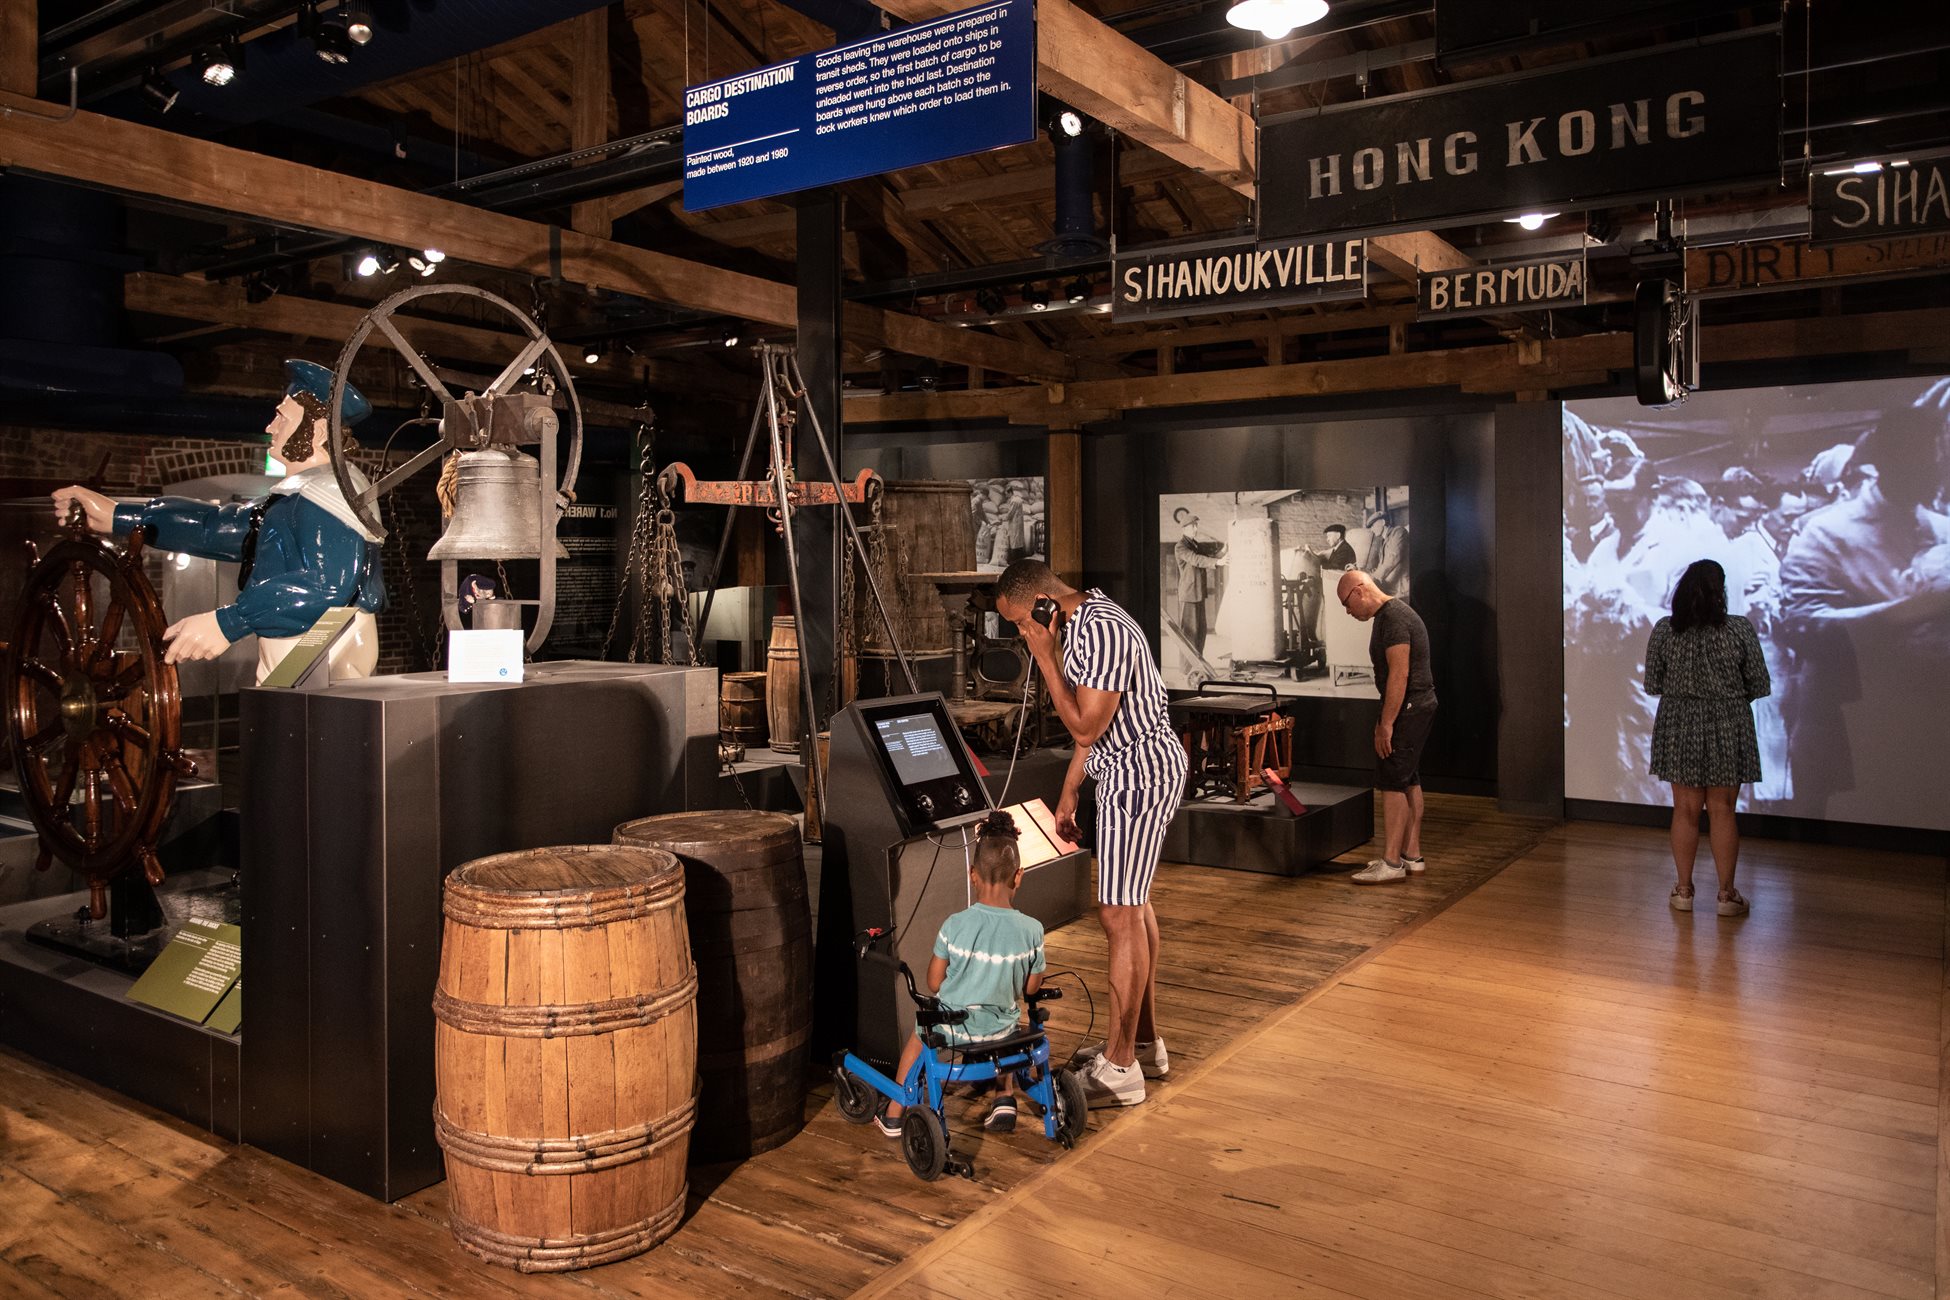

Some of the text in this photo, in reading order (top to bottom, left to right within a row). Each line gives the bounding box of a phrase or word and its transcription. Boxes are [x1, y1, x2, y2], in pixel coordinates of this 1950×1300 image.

[816, 9, 1007, 68] Goods leaving the warehouse were prepared in
[816, 26, 998, 81] transit sheds. They were loaded onto ships in
[687, 66, 794, 108] CARGO DESTINATION
[816, 40, 1002, 95] reverse order, so the first batch of cargo to be
[816, 56, 995, 108] unloaded went into the hold last. Destination
[687, 102, 728, 126] BOARDS
[816, 72, 990, 122] boards were hung above each batch so the
[816, 81, 1011, 135] dock workers knew which order to load them in.
[687, 148, 734, 166] Painted wood,
[687, 148, 788, 179] made between 1920 and 1980
[1308, 90, 1705, 200] HONG KONG
[1832, 167, 1950, 229] SIHA
[1124, 239, 1362, 302] SIHANOUKVILLE
[1430, 259, 1582, 311] BERMUDA
